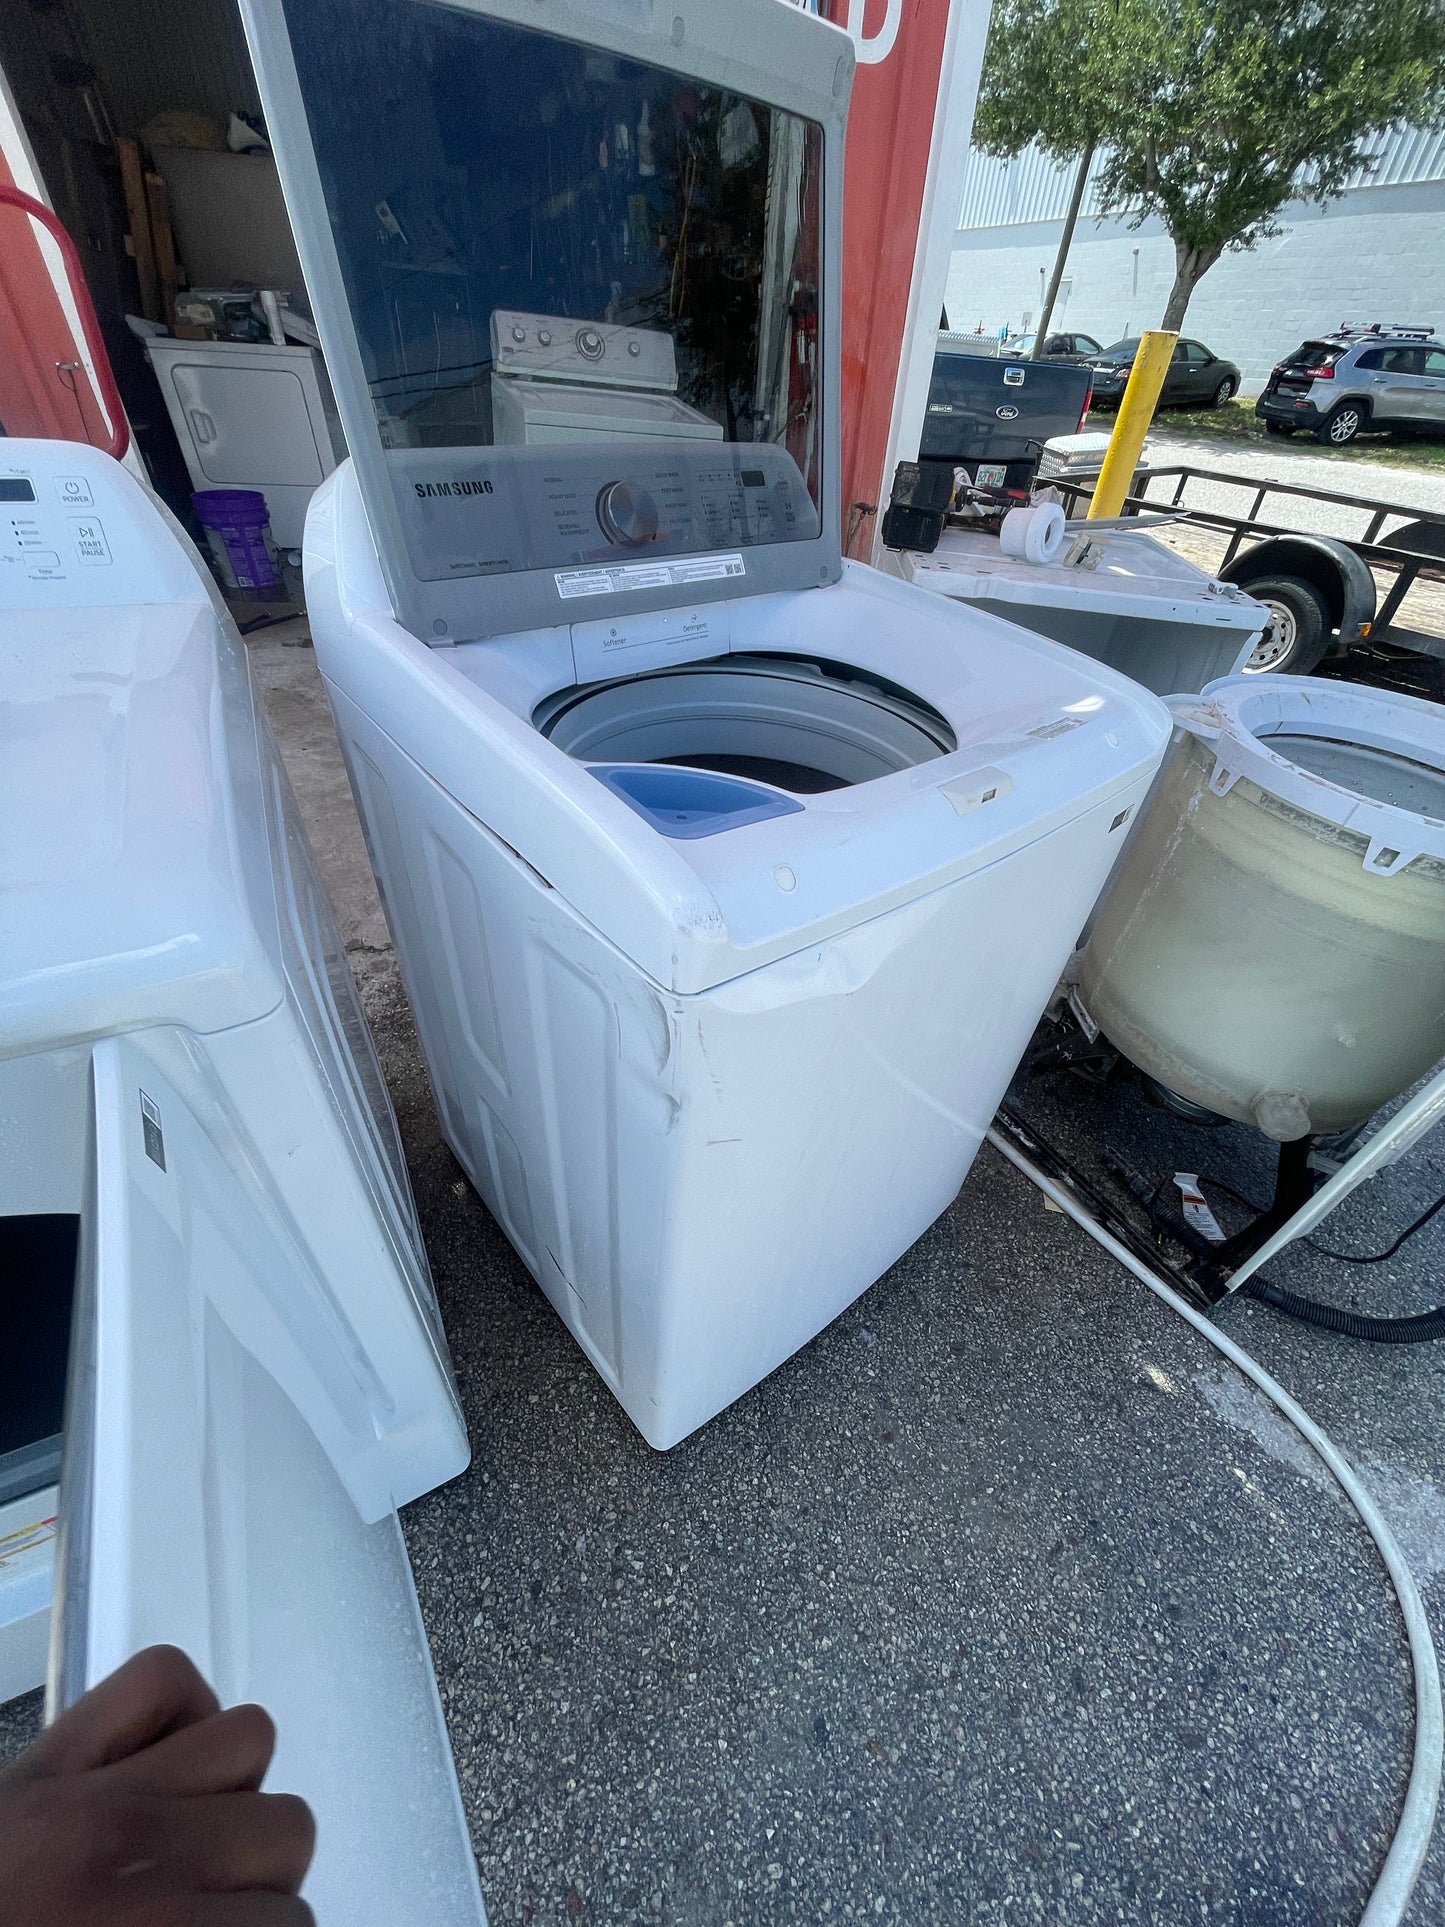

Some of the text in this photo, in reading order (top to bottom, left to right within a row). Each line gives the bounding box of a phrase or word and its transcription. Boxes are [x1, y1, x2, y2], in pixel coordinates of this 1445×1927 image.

[414, 480, 494, 498] SAMSUNG
[682, 622, 707, 633] Detergent
[603, 638, 627, 648] Softener
